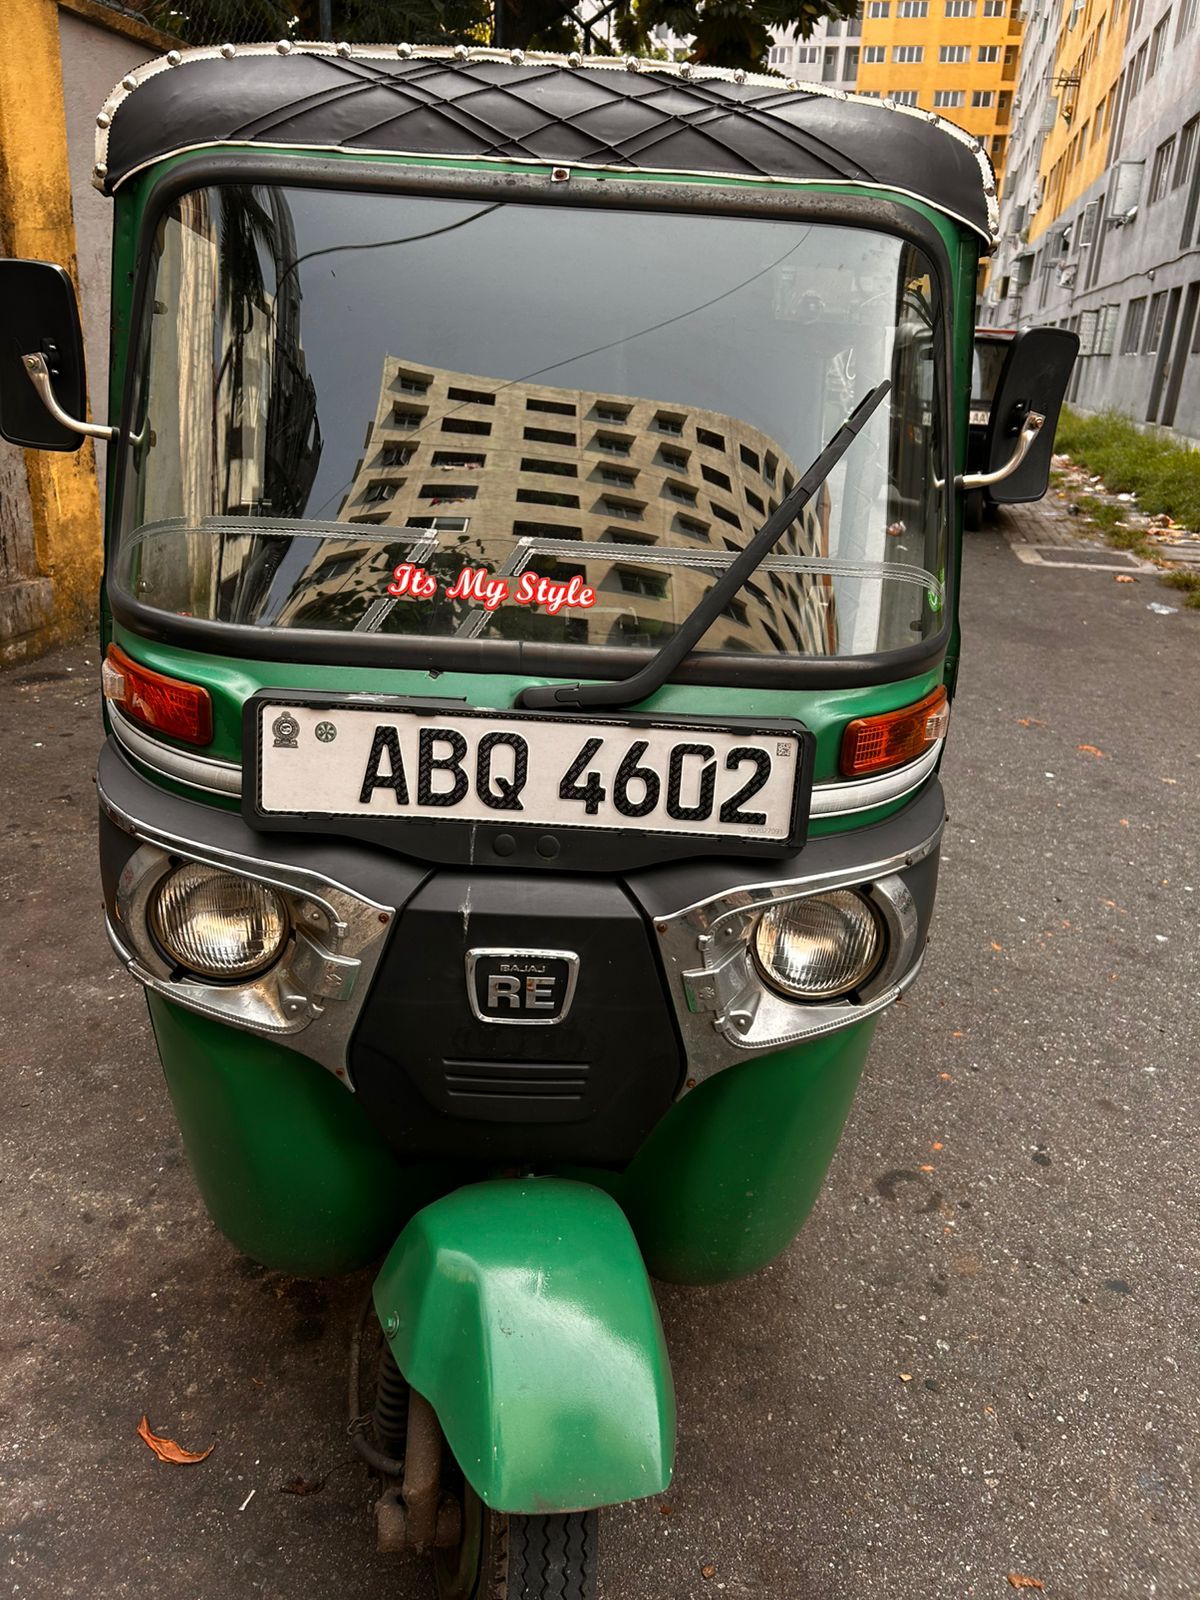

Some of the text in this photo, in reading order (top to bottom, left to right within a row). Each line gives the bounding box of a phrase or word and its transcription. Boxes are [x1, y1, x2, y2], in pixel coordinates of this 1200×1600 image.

[388, 563, 597, 615] Its My Style
[359, 725, 772, 825] ABQ 4602
[500, 964, 546, 973] BAJAJ
[487, 974, 556, 1009] RE
